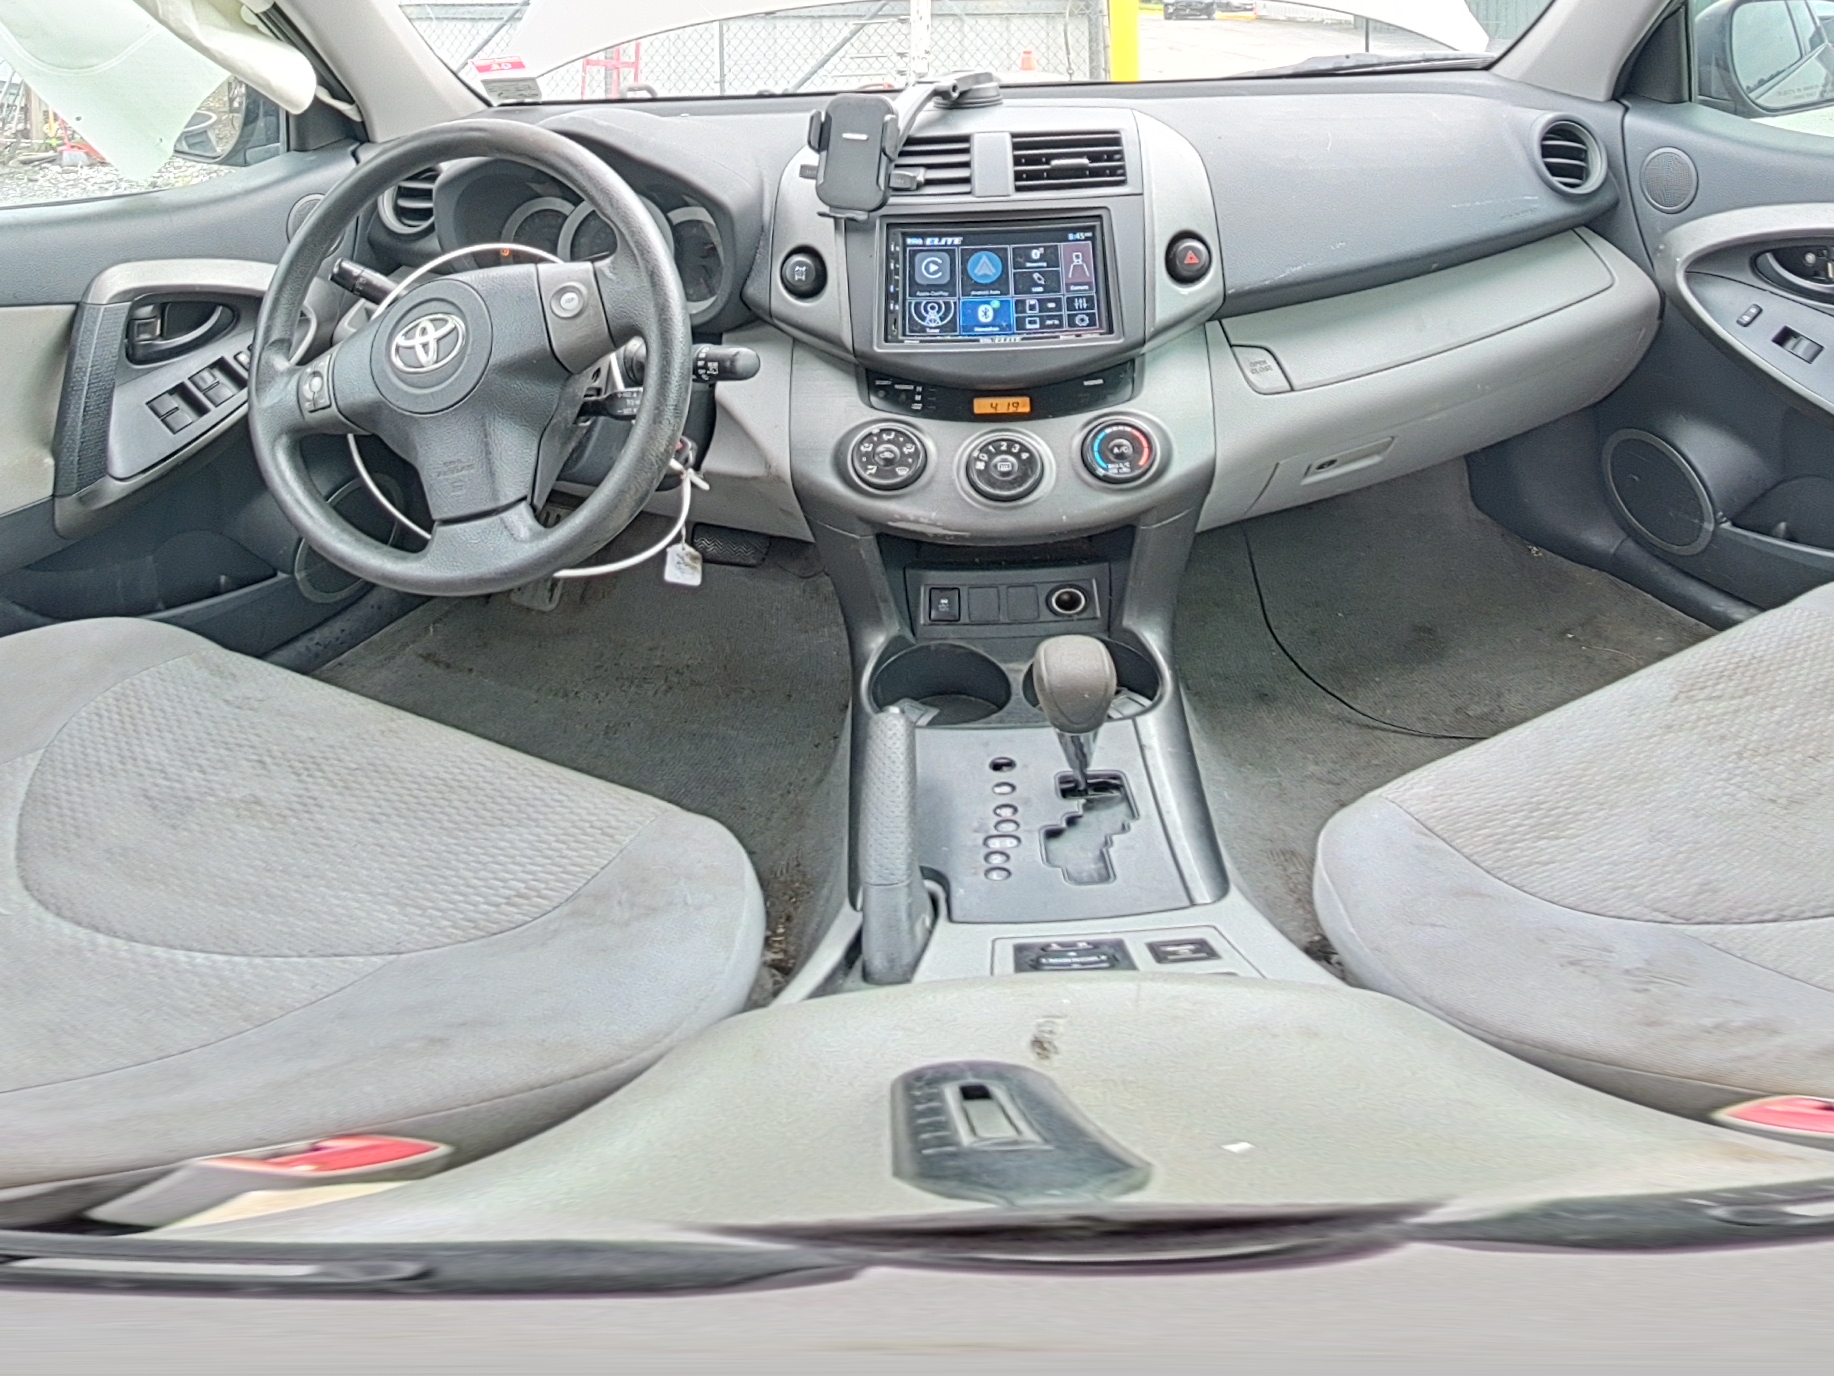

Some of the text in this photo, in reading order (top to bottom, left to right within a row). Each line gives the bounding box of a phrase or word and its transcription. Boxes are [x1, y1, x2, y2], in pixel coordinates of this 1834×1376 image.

[925, 236, 963, 245] ELITE
[1000, 441, 1007, 451] 2
[1011, 444, 1020, 452] 3
[1112, 446, 1128, 454] A/C
